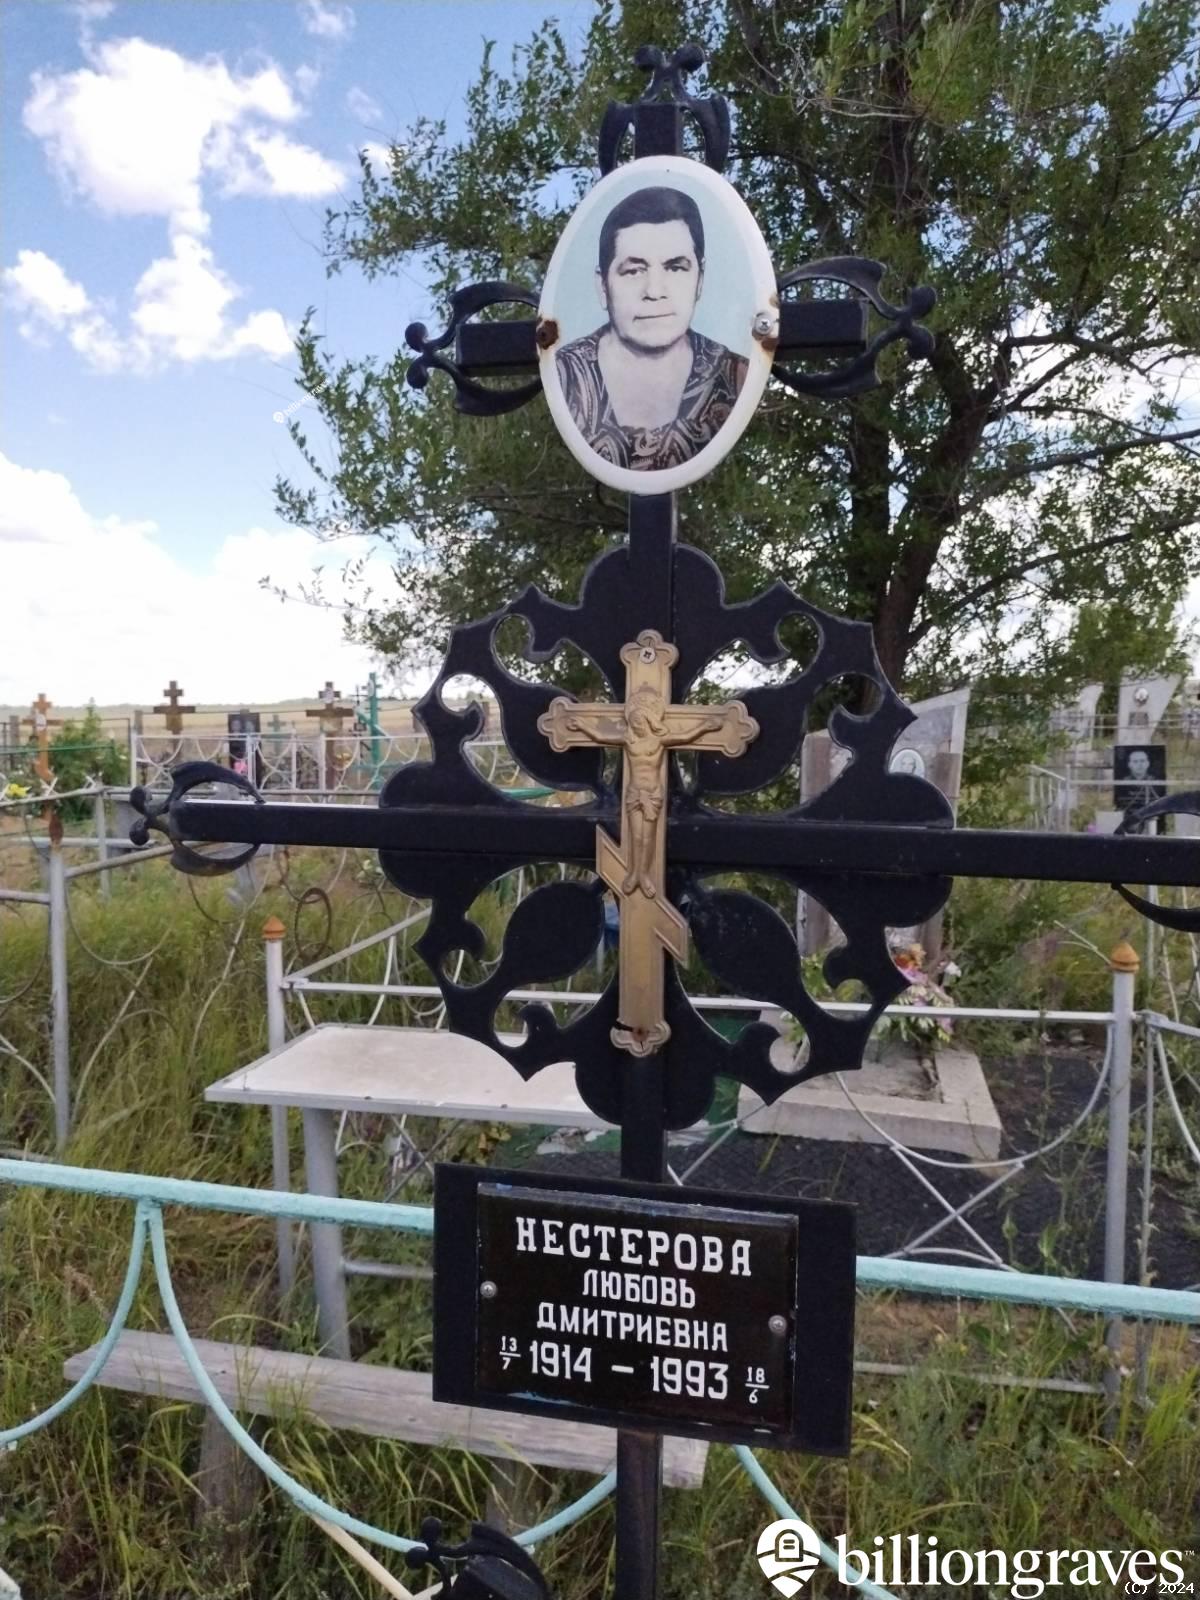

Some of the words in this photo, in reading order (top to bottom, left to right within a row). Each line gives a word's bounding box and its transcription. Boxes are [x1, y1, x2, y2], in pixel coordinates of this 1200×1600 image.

[516, 1217, 752, 1277] НЕСТЕРОВА
[583, 1269, 696, 1309] ЛЮБОВЬ
[537, 1302, 728, 1353] ДМИТРИЕВНА
[529, 1340, 592, 1383] 1914
[651, 1356, 729, 1400] 1993
